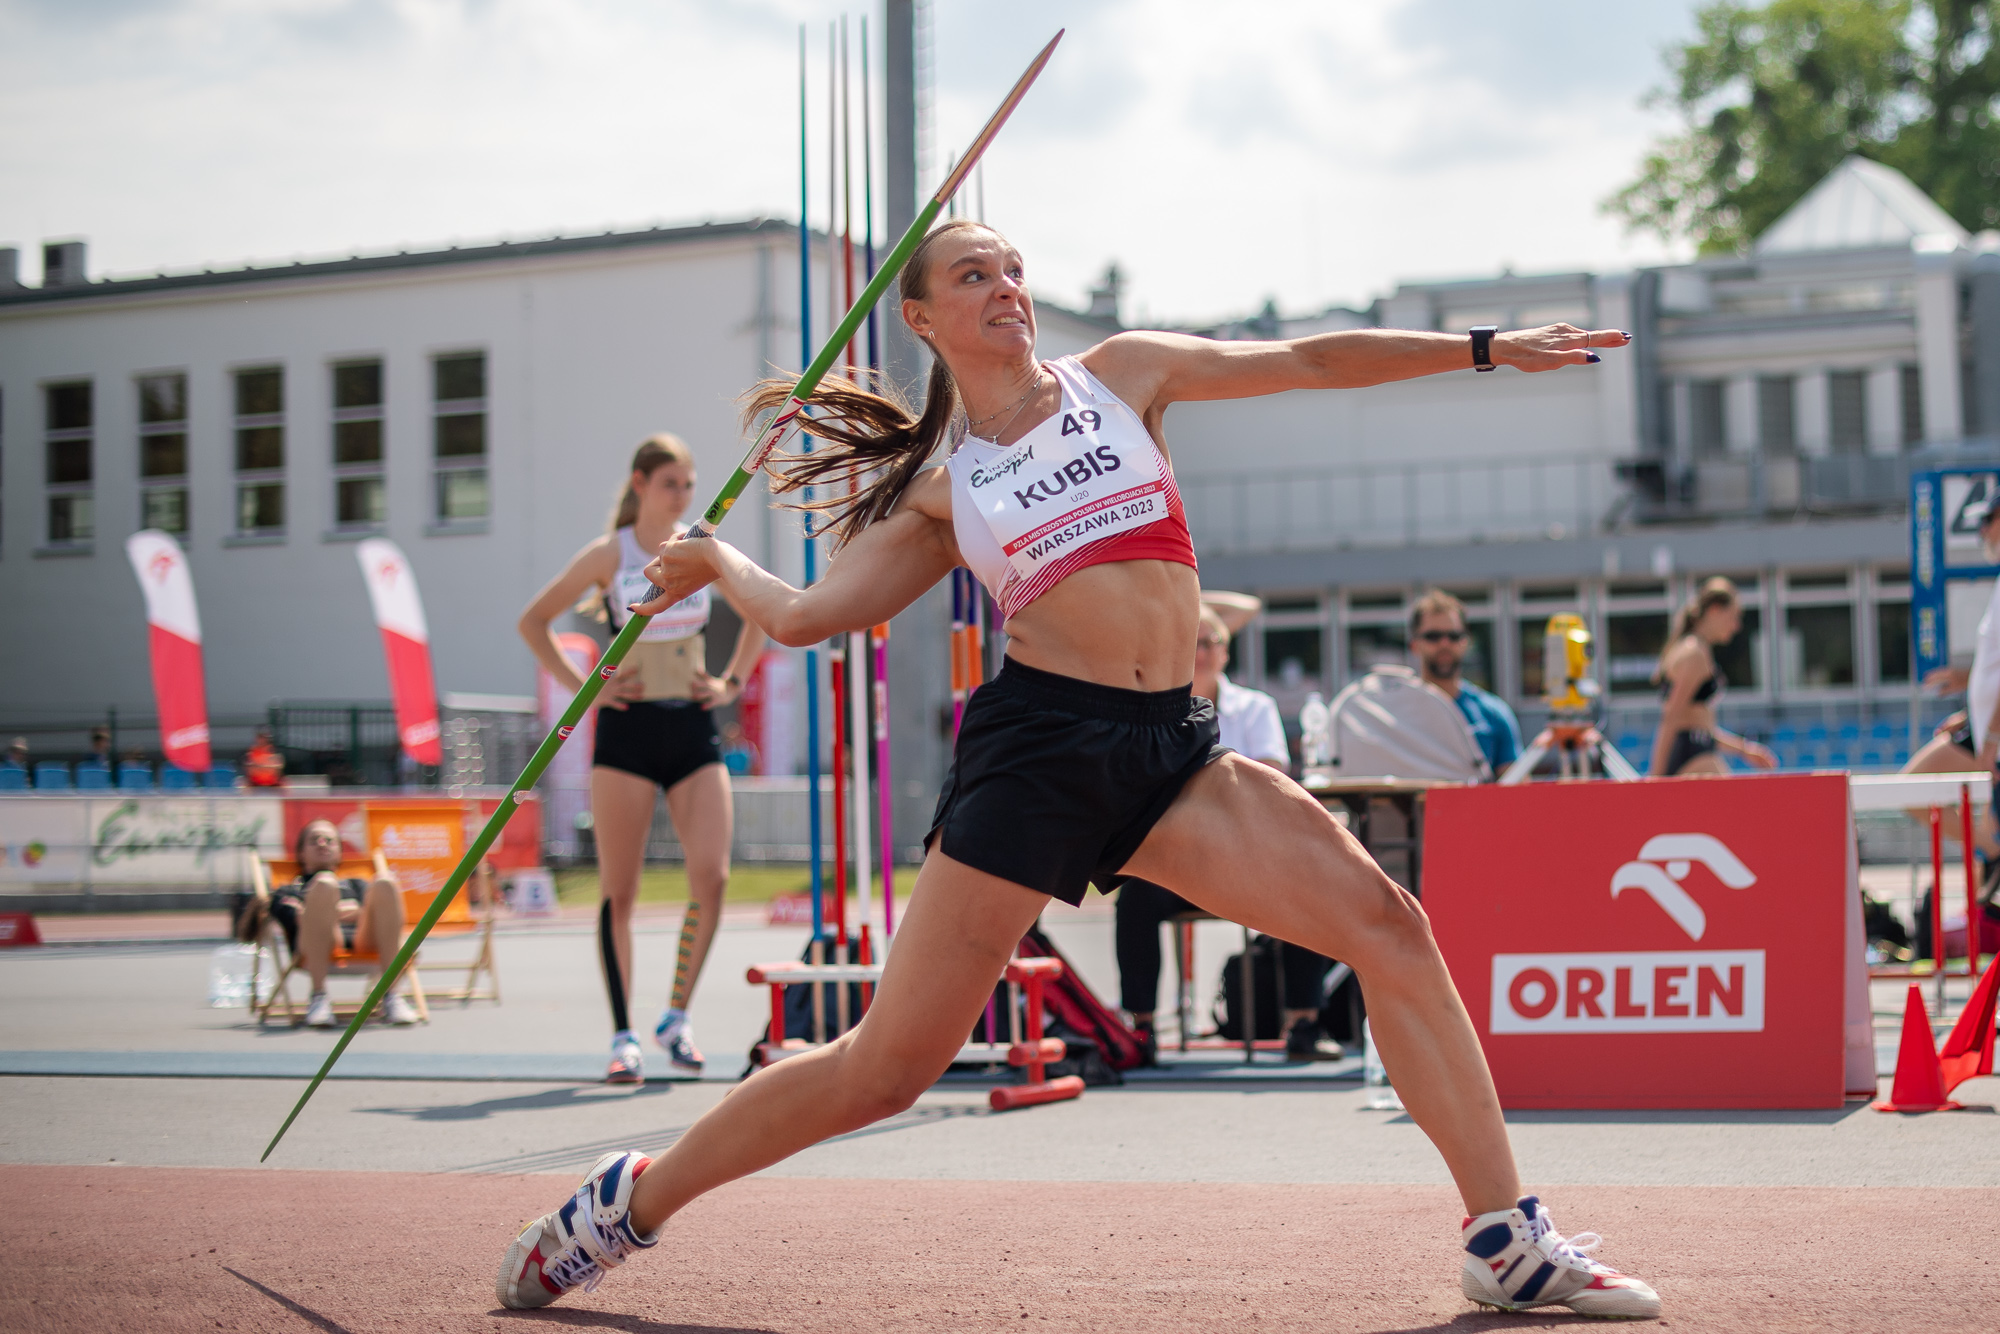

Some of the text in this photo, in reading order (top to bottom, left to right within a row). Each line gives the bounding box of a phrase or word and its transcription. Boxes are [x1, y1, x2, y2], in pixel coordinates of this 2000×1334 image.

[1061, 409, 1102, 437] 49
[971, 445, 1034, 488] Europol
[989, 452, 1021, 473] INTER
[1013, 445, 1121, 510] KUBIS
[1013, 484, 1156, 550] PZLA MISTRZOSTWA POLSKI W WIELOBOJACH 2023
[1070, 490, 1089, 503] U20
[1026, 499, 1154, 561] WARSZAWA 2023
[1508, 964, 1745, 1020] ORLEN
